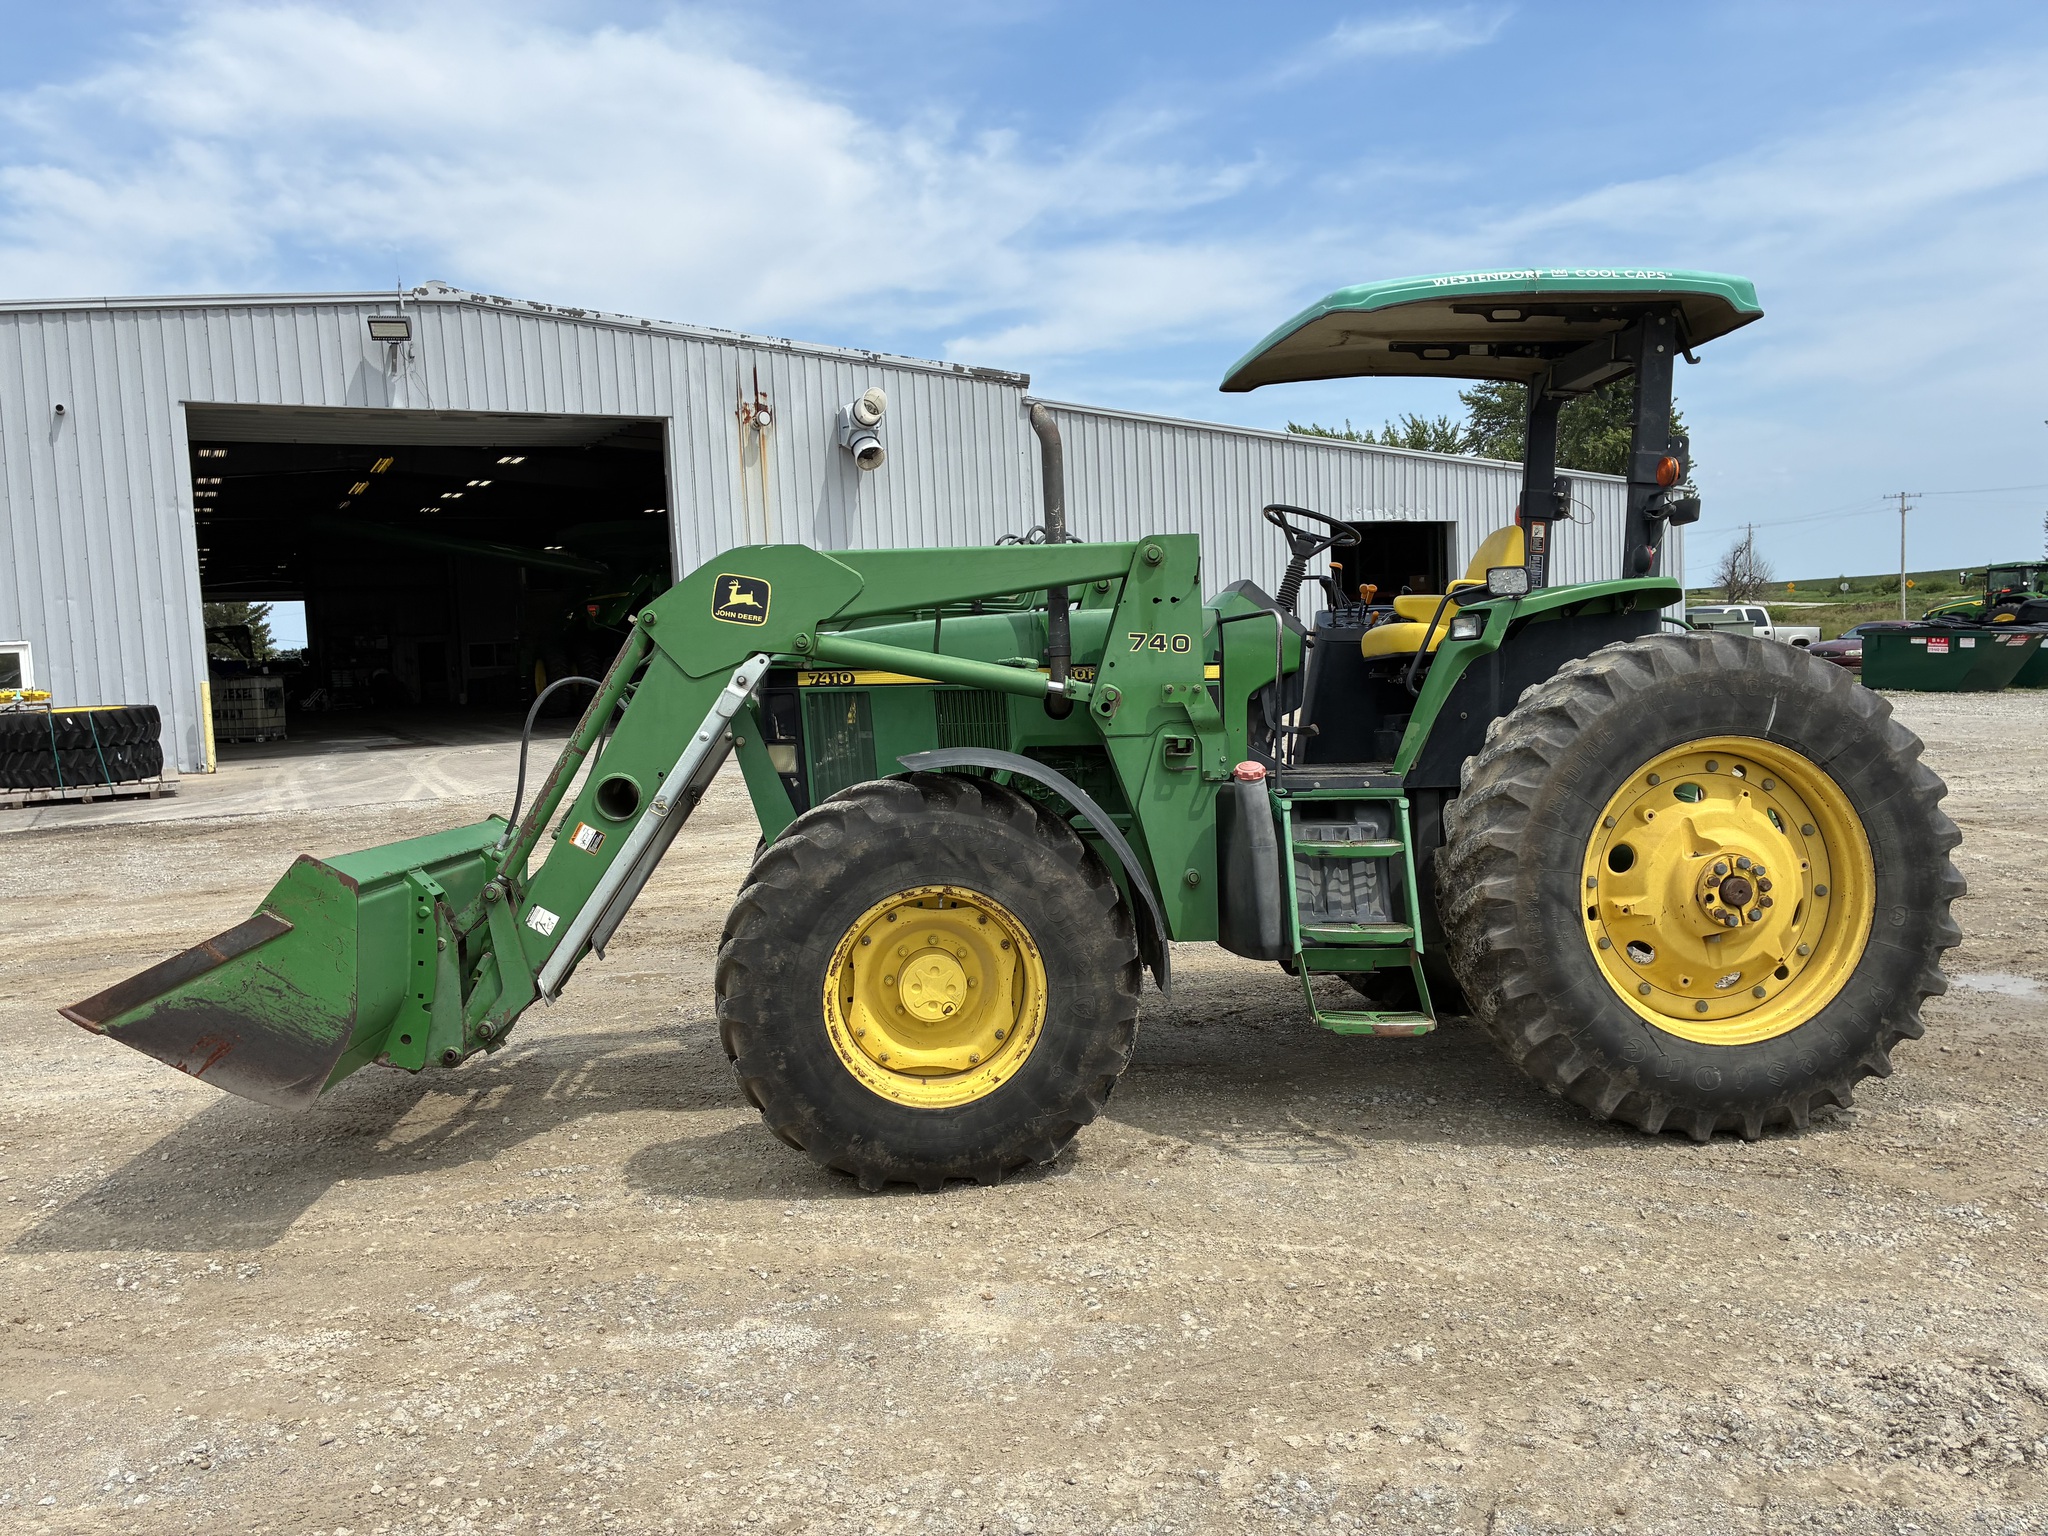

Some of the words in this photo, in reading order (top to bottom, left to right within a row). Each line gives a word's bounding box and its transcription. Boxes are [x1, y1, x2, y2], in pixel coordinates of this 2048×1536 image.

[1432, 270, 1544, 286] WESTENDORF
[1575, 269, 1619, 277] COOL
[715, 609, 737, 618] JOHN
[737, 613, 763, 622] DEERE
[1128, 632, 1191, 653] 740
[808, 672, 855, 685] 7410
[1545, 728, 1617, 818] RADIAL
